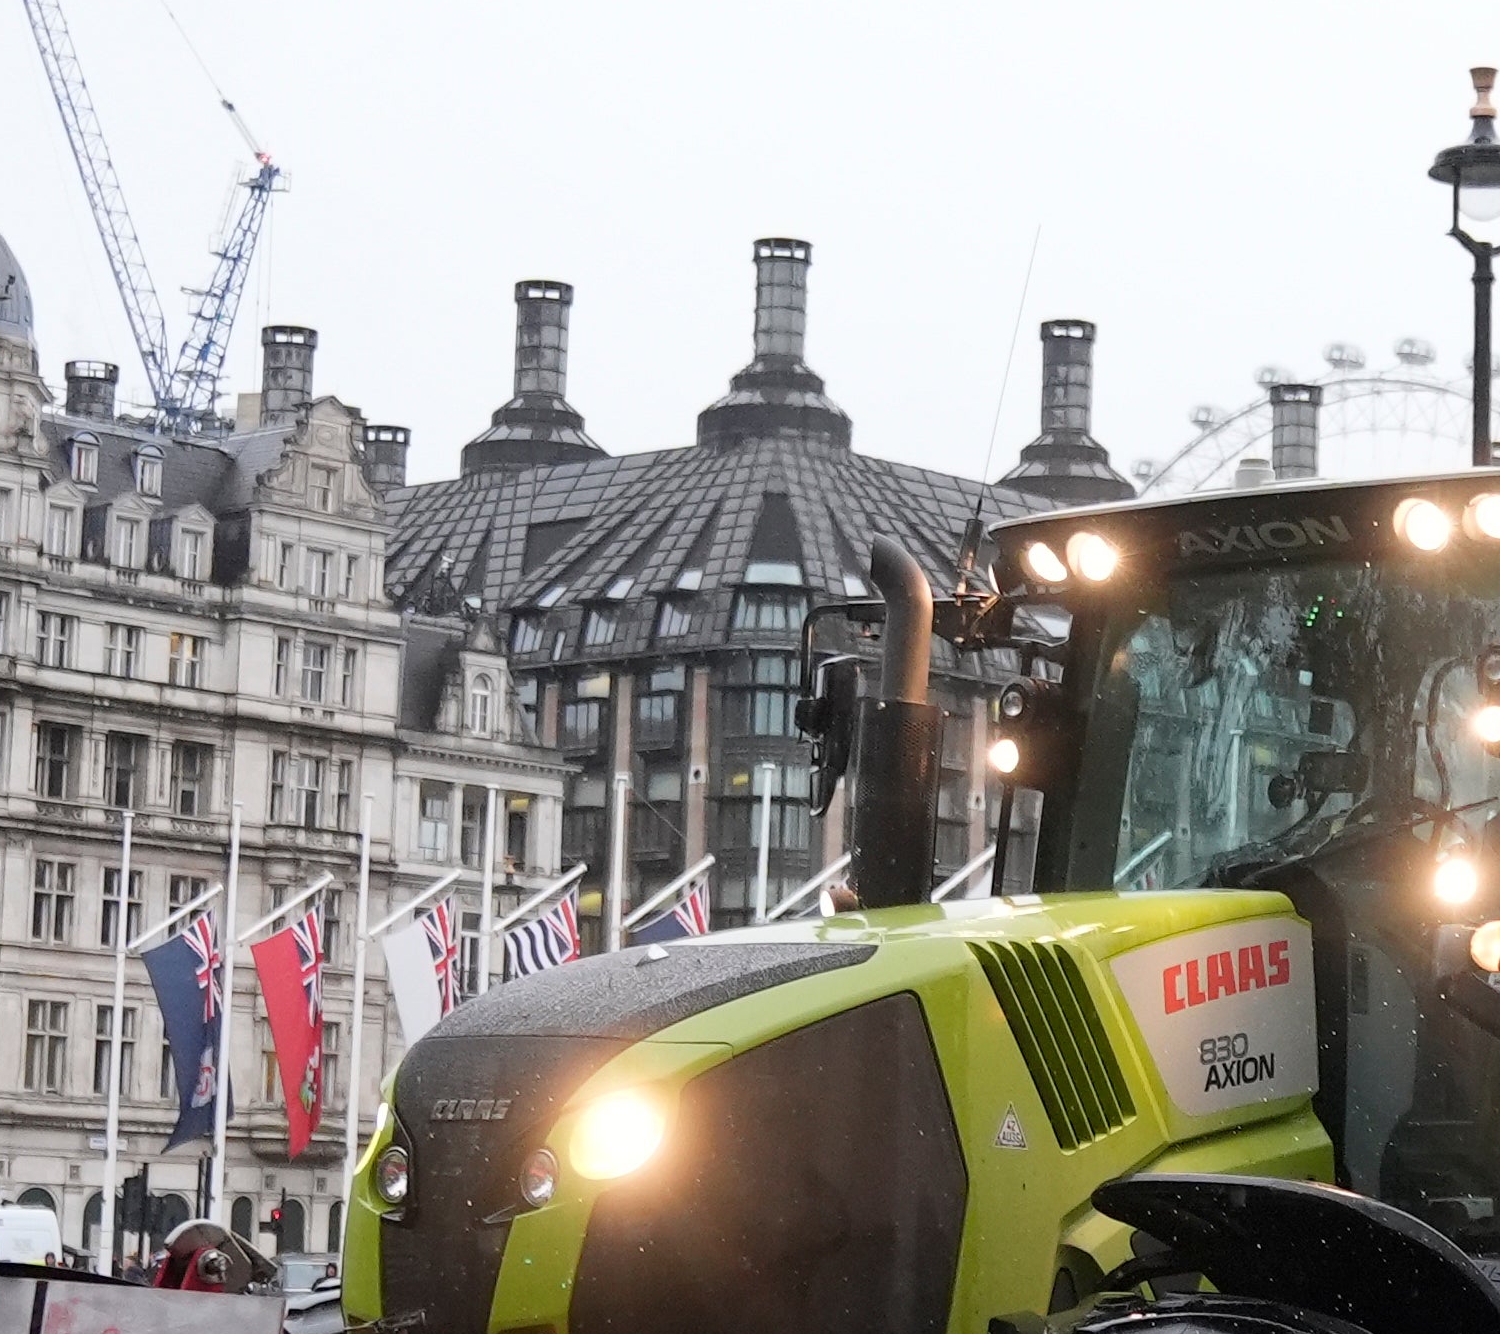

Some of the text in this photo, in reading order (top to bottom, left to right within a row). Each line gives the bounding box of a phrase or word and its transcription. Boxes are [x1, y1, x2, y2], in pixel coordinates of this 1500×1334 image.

[1179, 514, 1354, 559] AXION
[1162, 939, 1290, 1015] CLAAS
[1201, 1032, 1249, 1067] 830
[1203, 1052, 1275, 1094] AXION
[430, 1098, 513, 1121] CLAAS
